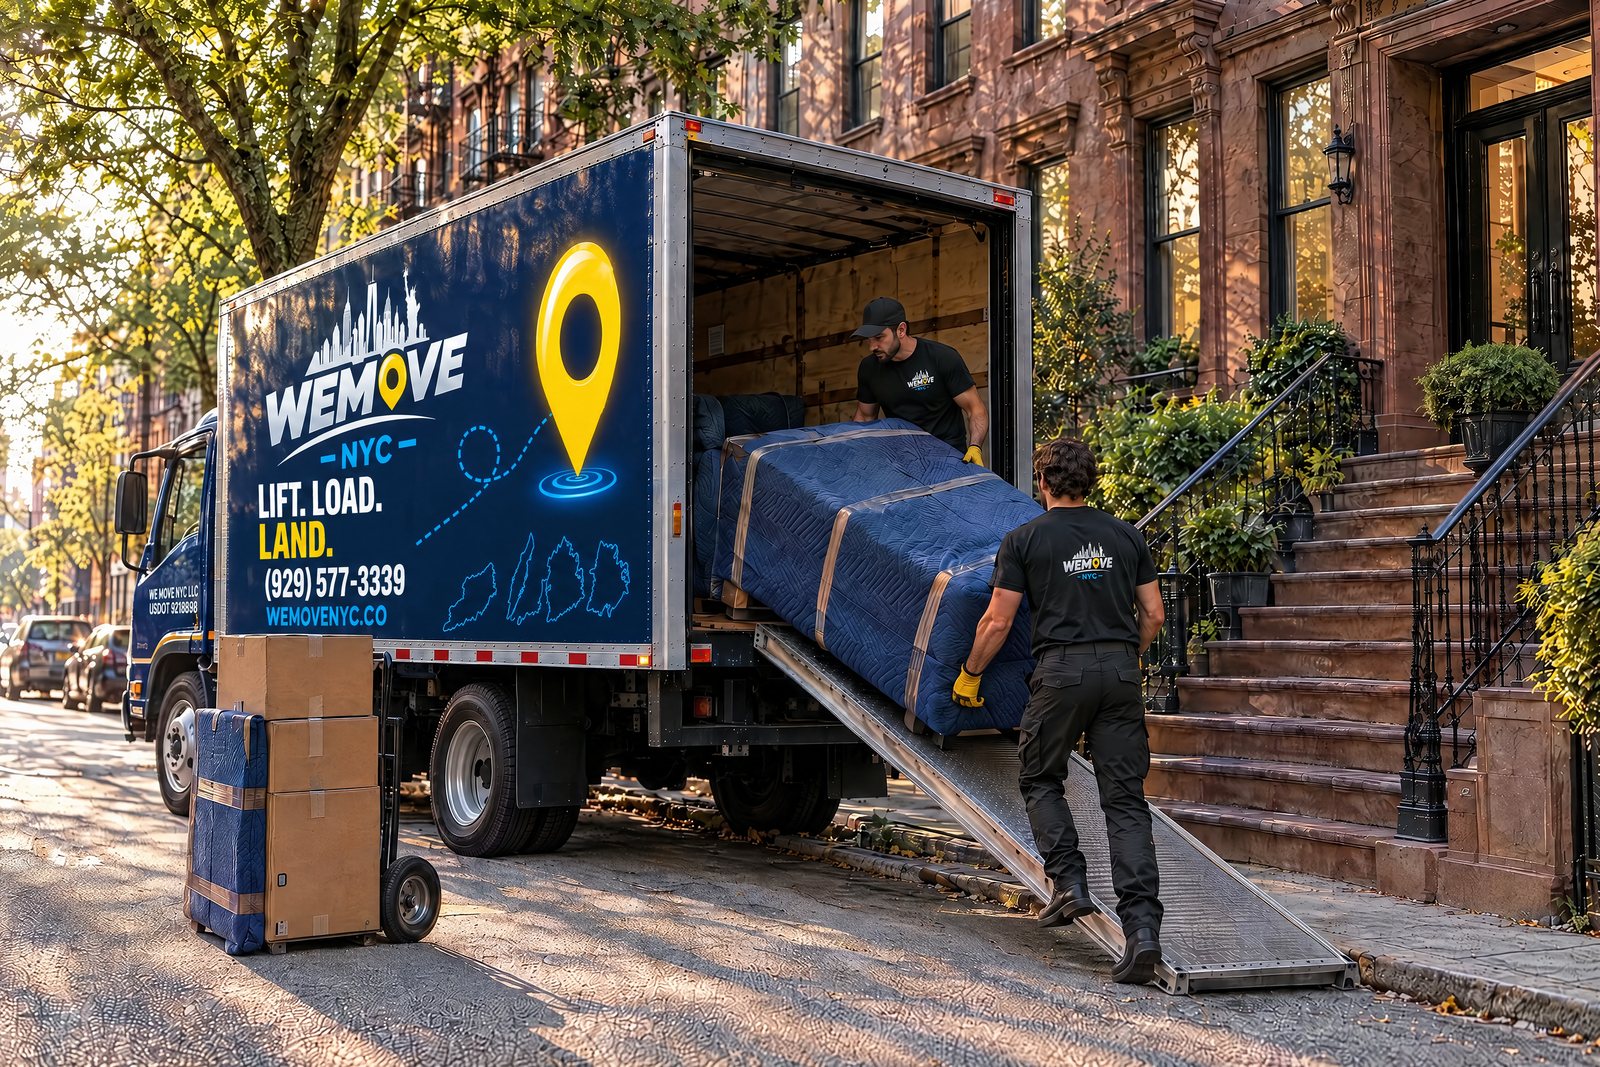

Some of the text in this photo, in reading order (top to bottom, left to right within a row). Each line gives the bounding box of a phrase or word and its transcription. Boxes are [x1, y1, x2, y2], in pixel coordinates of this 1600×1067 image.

[265, 332, 468, 447] WEMOVE
[907, 376, 934, 388] WEMOVE
[341, 434, 392, 470] NYC
[258, 475, 382, 519] LIFT. LOAD.
[259, 520, 333, 560] LAND.
[1063, 557, 1112, 572] WEMOVE
[149, 585, 198, 600] WE MOVE NYC LLC
[265, 563, 406, 602] (929) 577-3339
[149, 602, 170, 615] USDOT
[266, 604, 388, 627] WEMOVENYC.CO
